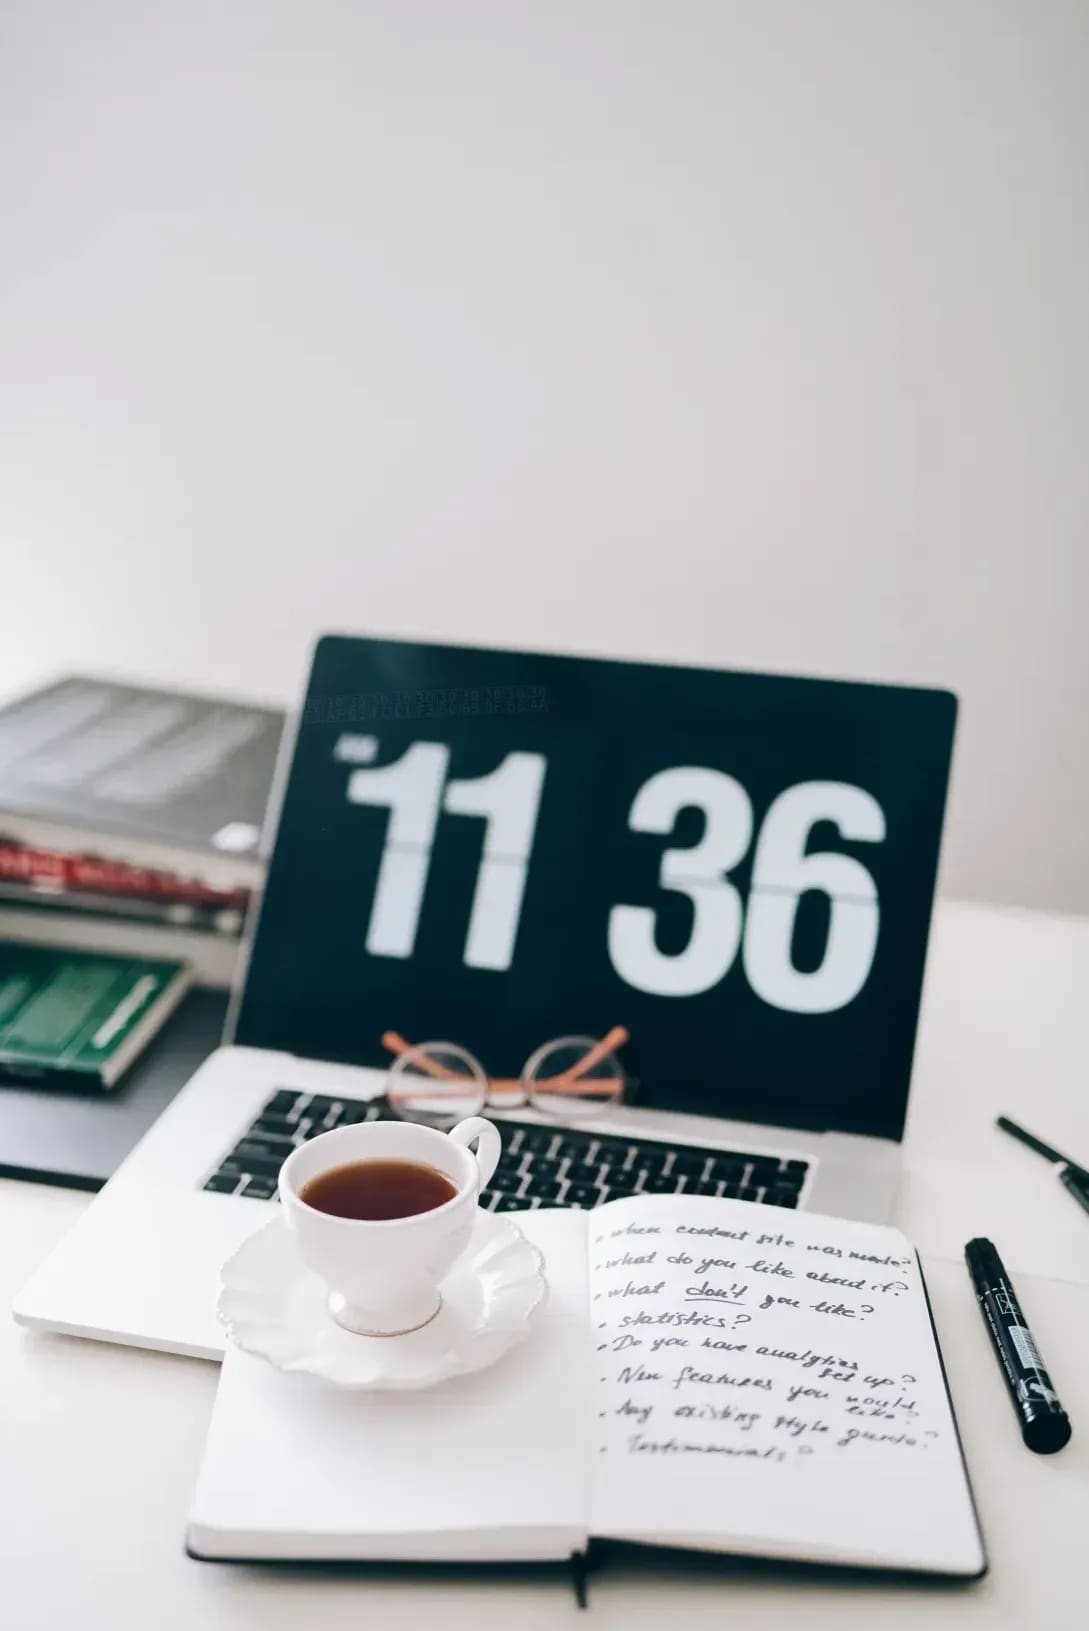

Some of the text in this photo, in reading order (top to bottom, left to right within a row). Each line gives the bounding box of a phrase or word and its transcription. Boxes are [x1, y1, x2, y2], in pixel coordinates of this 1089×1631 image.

[346, 741, 887, 1014] 11 36
[606, 1251, 656, 1268] what
[667, 1252, 693, 1264] do
[694, 1258, 736, 1274] you
[745, 1260, 795, 1278] like
[806, 1271, 866, 1289] about
[608, 1281, 874, 1320] what don't you like?
[612, 1335, 858, 1371] Do you have analytics
[672, 1366, 772, 1390] features
[787, 1386, 829, 1402] you
